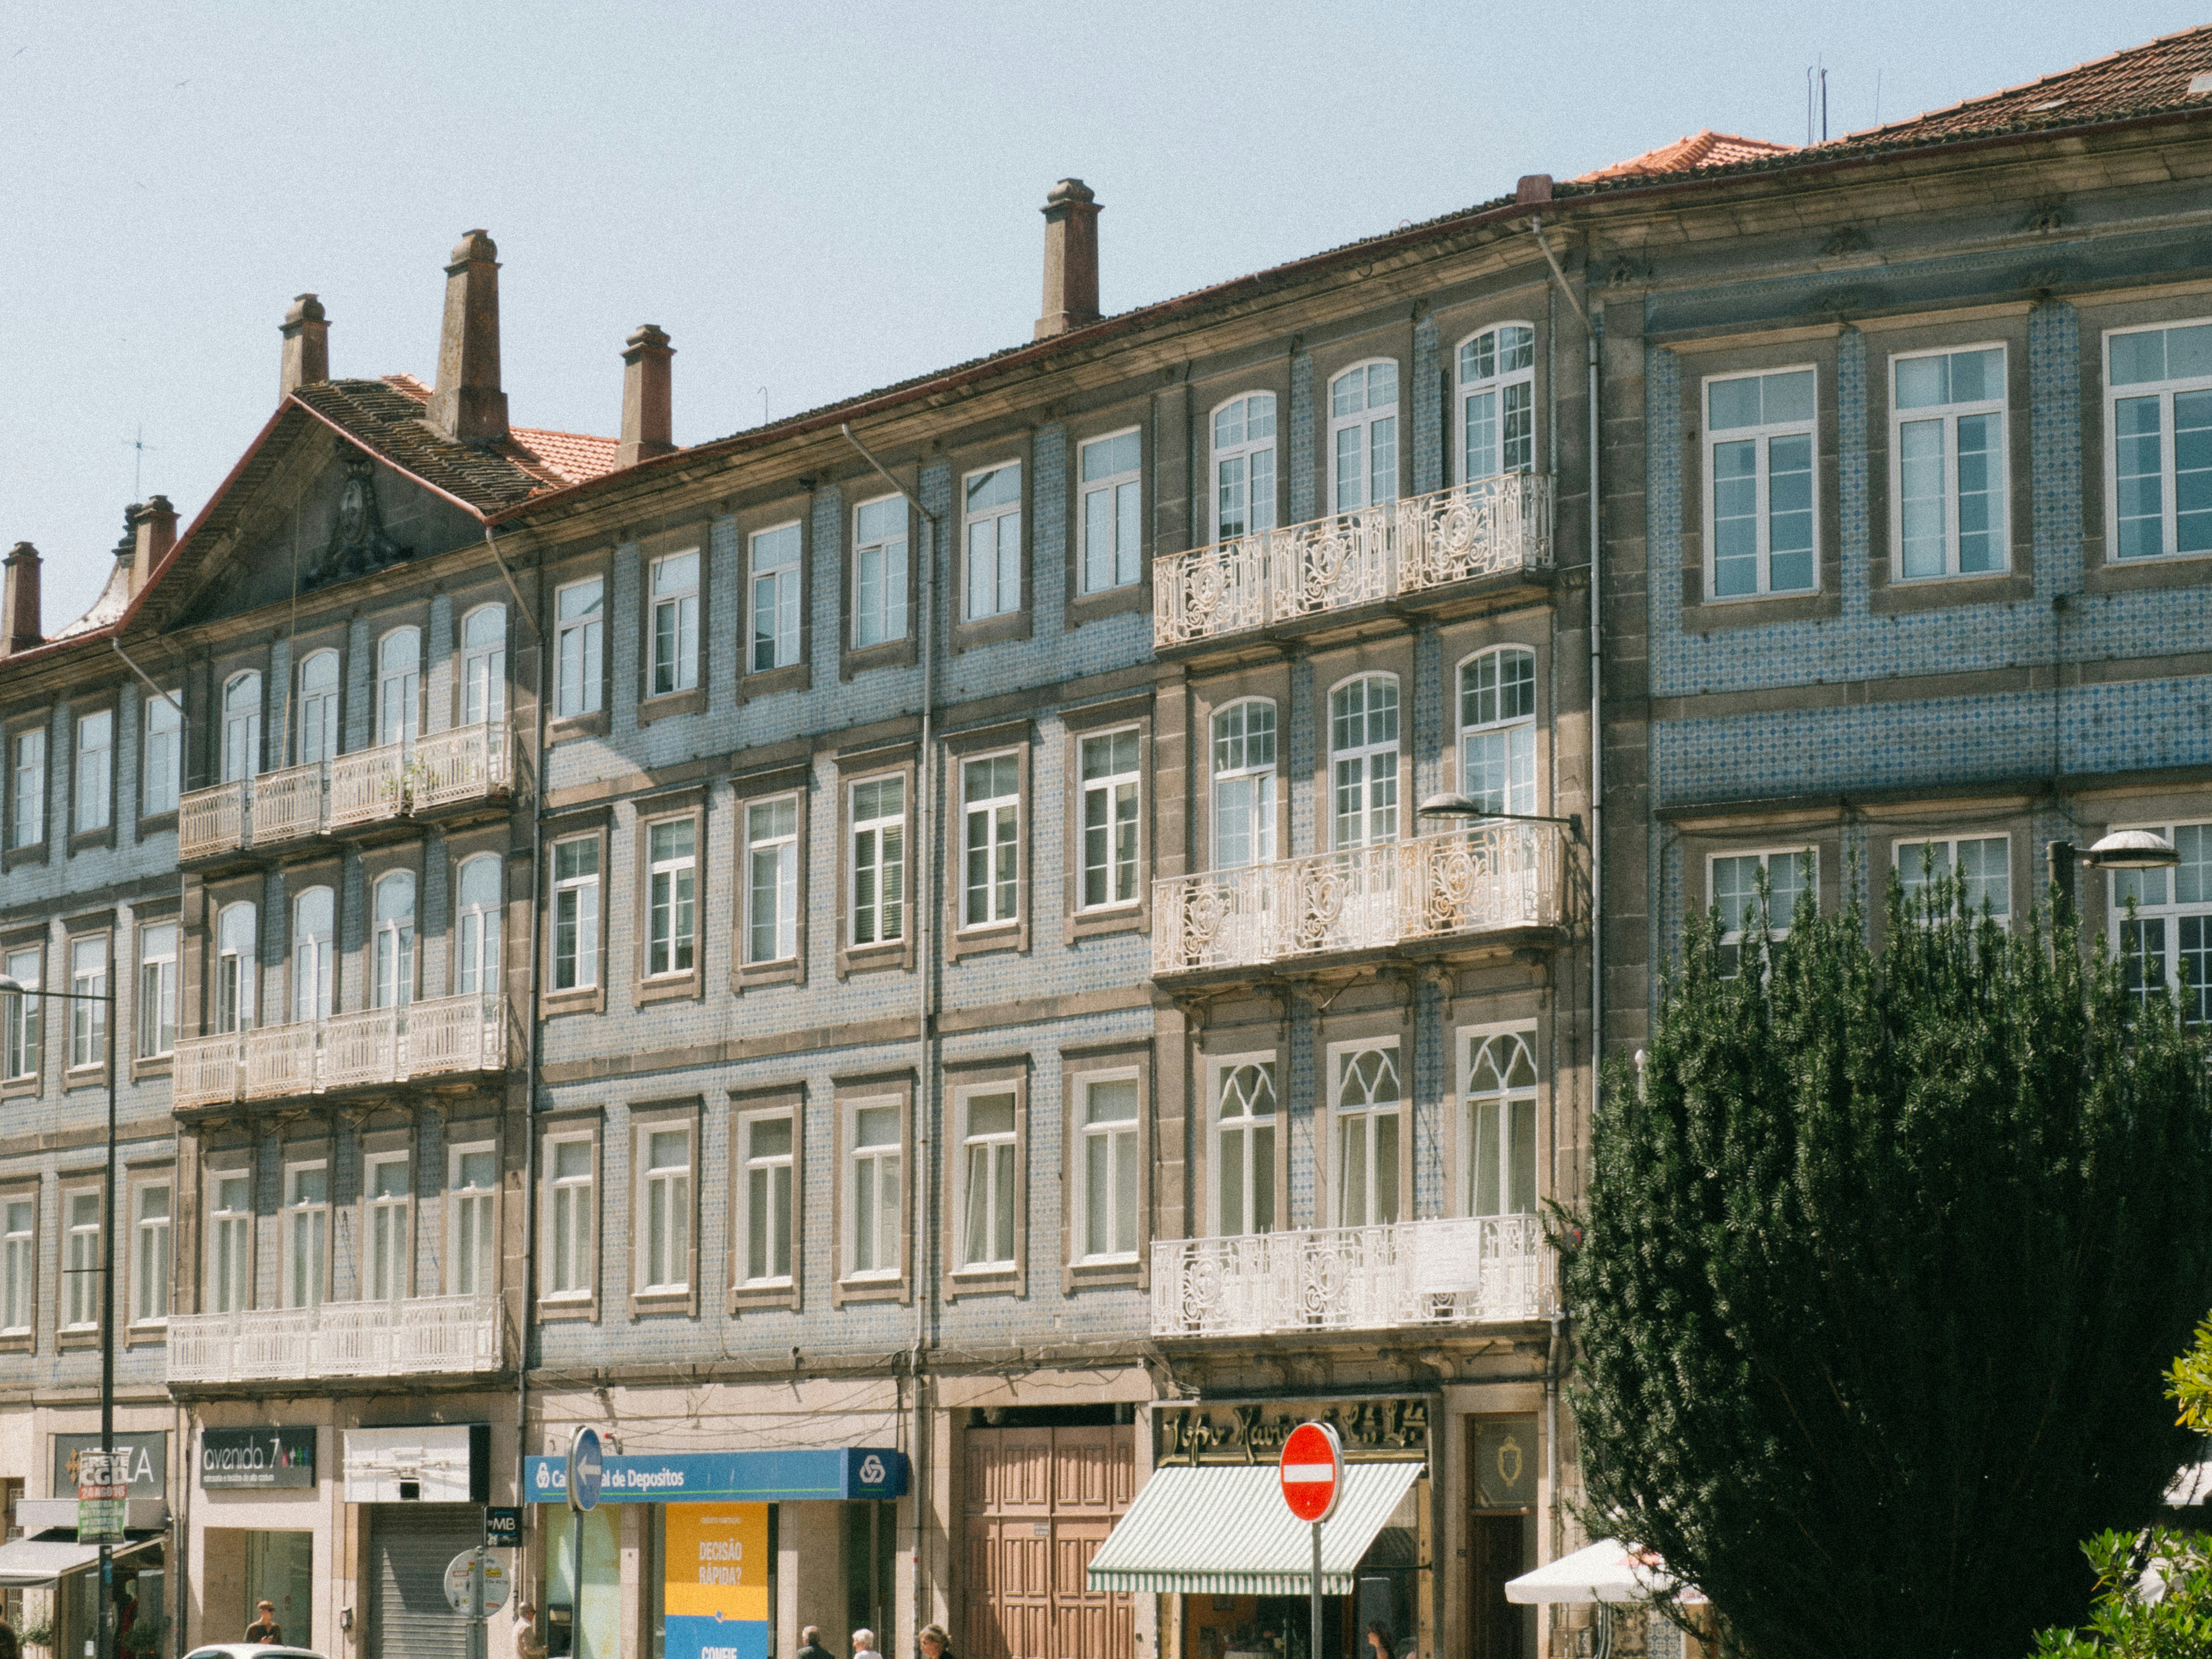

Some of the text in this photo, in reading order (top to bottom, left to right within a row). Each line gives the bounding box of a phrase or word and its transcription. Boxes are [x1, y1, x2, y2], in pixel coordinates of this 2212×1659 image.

[1233, 1408, 1298, 1465] Xavie
[81, 1456, 129, 1467] GREVE
[204, 1435, 280, 1470] avenida 7
[81, 1467, 128, 1486] CGD
[612, 1470, 626, 1487] de
[627, 1467, 684, 1491] Depositos
[81, 1488, 94, 1499] 24
[95, 1486, 112, 1497] AGO
[493, 1517, 516, 1530] MB
[699, 1538, 742, 1561] DECISÃO
[699, 1563, 742, 1585] RÁPIDA?
